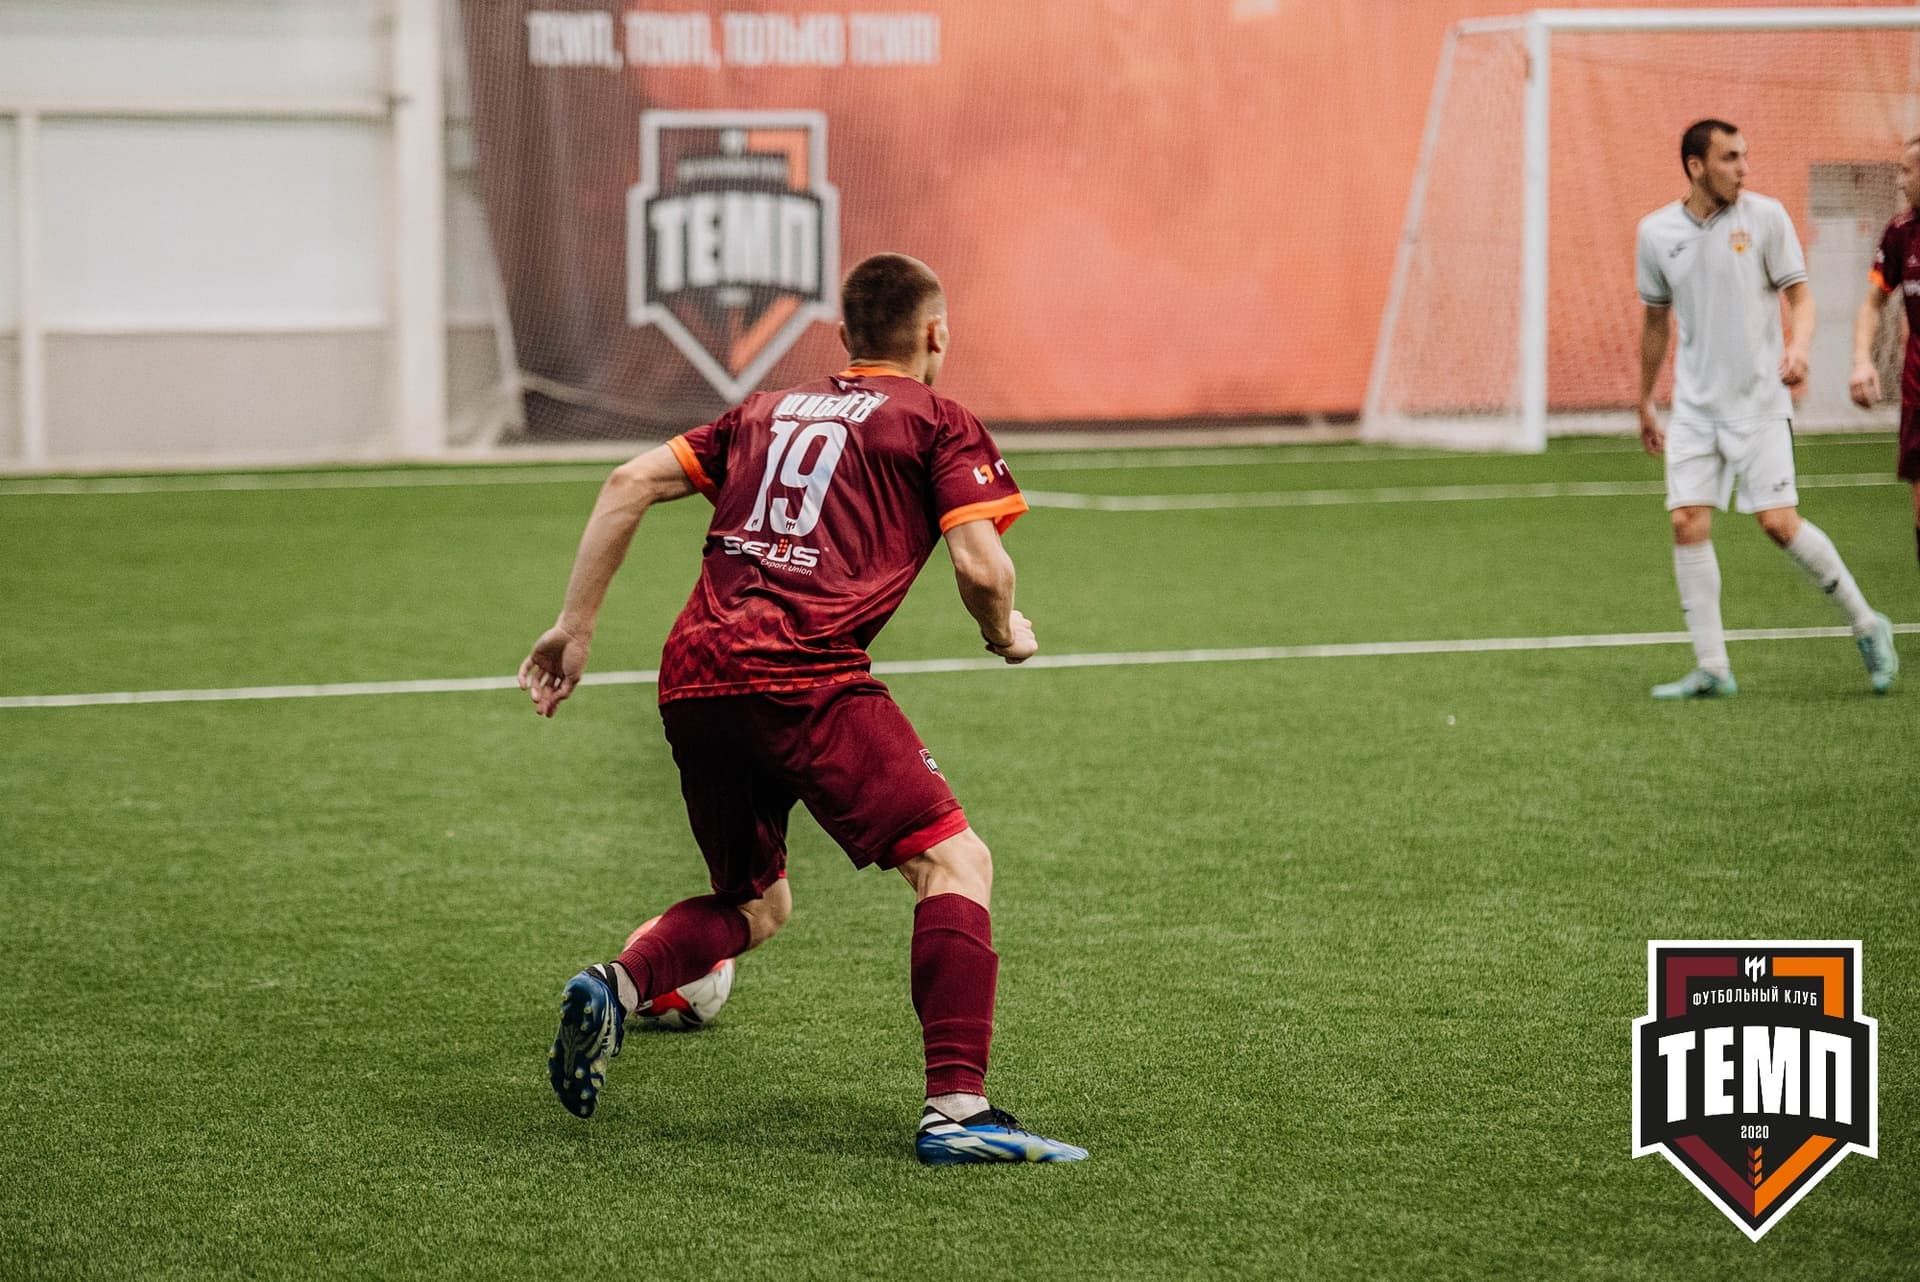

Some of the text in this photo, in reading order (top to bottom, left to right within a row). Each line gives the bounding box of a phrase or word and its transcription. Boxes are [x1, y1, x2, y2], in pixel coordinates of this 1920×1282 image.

[652, 191, 819, 294] ТЕМП
[744, 420, 848, 537] 19
[760, 558, 812, 576] Export Union
